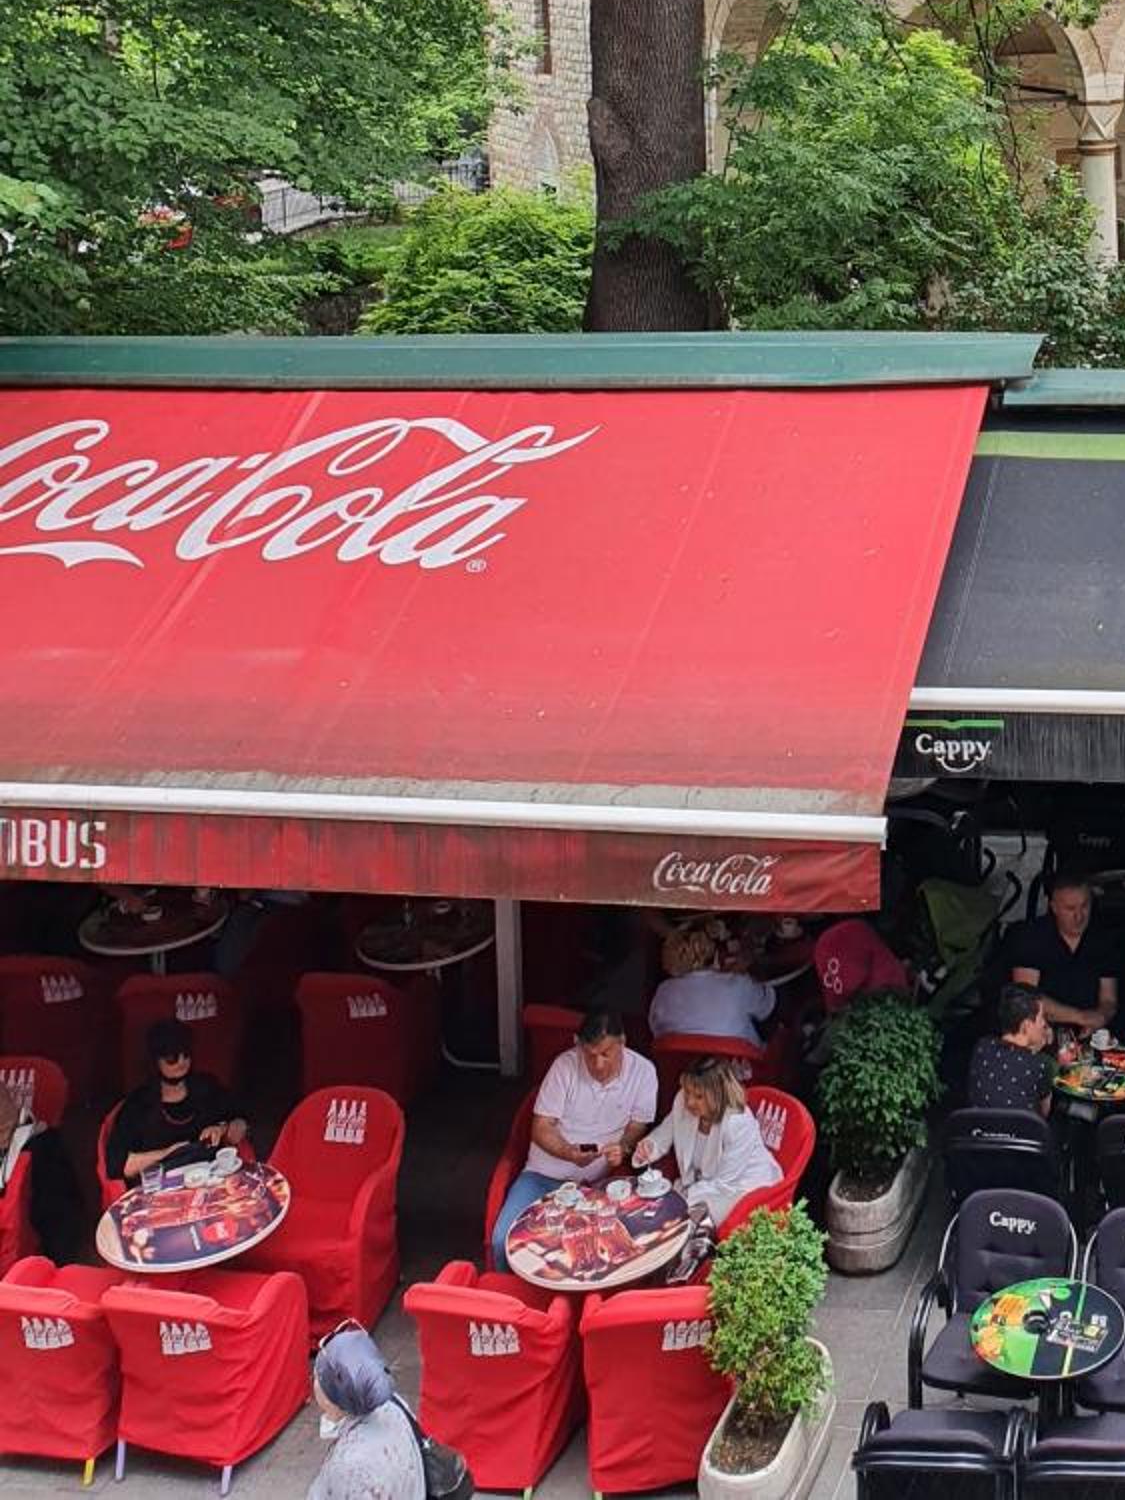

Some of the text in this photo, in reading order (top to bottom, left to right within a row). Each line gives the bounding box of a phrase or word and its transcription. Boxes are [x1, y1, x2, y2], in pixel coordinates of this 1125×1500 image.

[915, 733, 991, 761] Cappy
[653, 851, 783, 895] Coca-Cola
[989, 1211, 1036, 1234] Cappy
